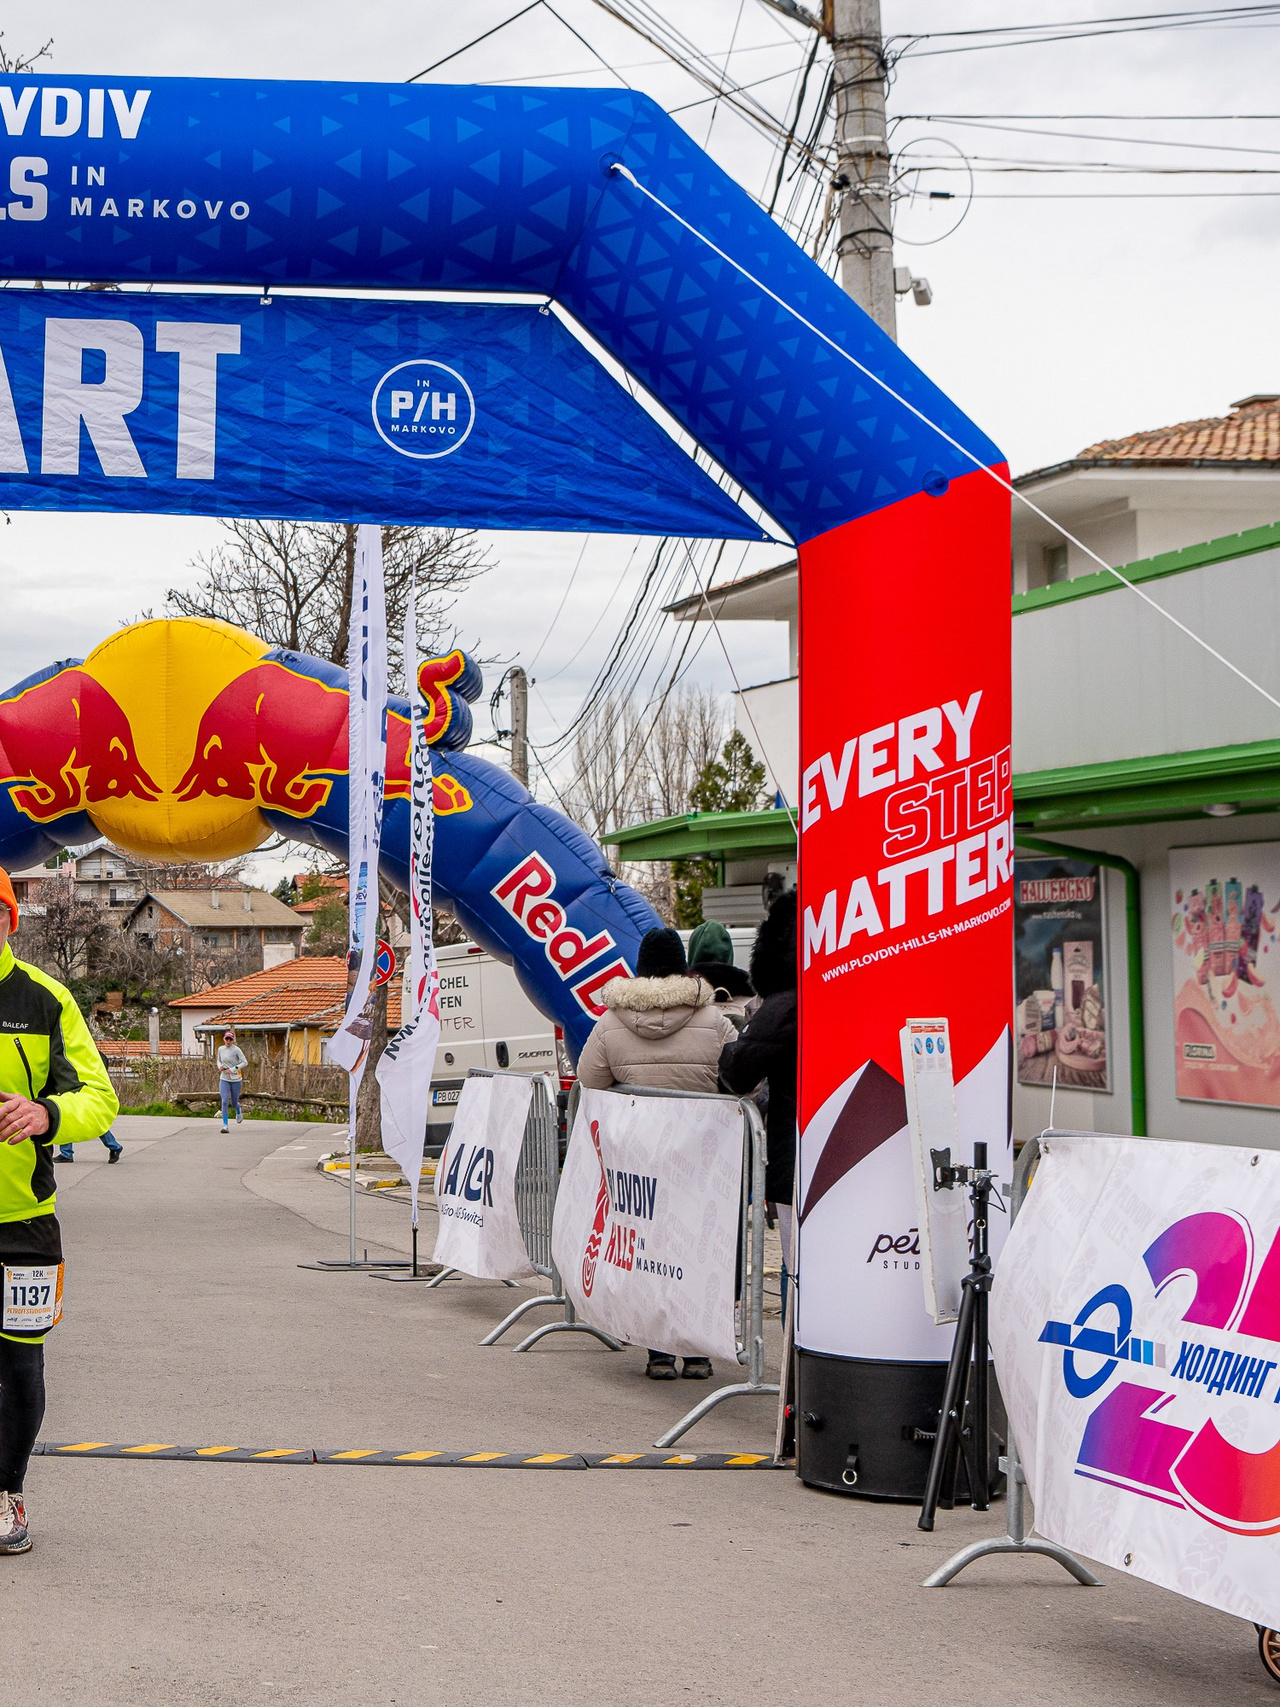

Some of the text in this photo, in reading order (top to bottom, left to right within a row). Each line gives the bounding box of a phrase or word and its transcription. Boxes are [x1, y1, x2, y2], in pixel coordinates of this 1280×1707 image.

[71, 166, 106, 186] IN
[71, 197, 251, 220] MARKOVO
[417, 379, 430, 387] IN
[391, 391, 456, 422] P/H
[391, 425, 455, 434] MARKOVO
[802, 690, 983, 833] EVERY
[883, 744, 1012, 858] STEP
[1020, 878, 1095, 902] НАШЕНСКО
[494, 855, 614, 979] Red
[821, 897, 1012, 982] WWW.PLOVDIV-HILLS-IN-MARKOVO.COM
[439, 976, 469, 990] CHEL
[440, 996, 462, 1009] FEN
[2, 1021, 29, 1030] BALEAF
[440, 1016, 475, 1031] ITER
[518, 1050, 553, 1059] DUCATO
[437, 1090, 459, 1101] PB 027
[606, 1168, 657, 1221] PLOVDIV
[637, 1236, 646, 1251] IN
[635, 1256, 683, 1280] MARKOVO
[883, 1261, 920, 1269] STUD
[10, 1285, 50, 1306] 1137
[1170, 1341, 1277, 1397] ХОЛДИНГ
